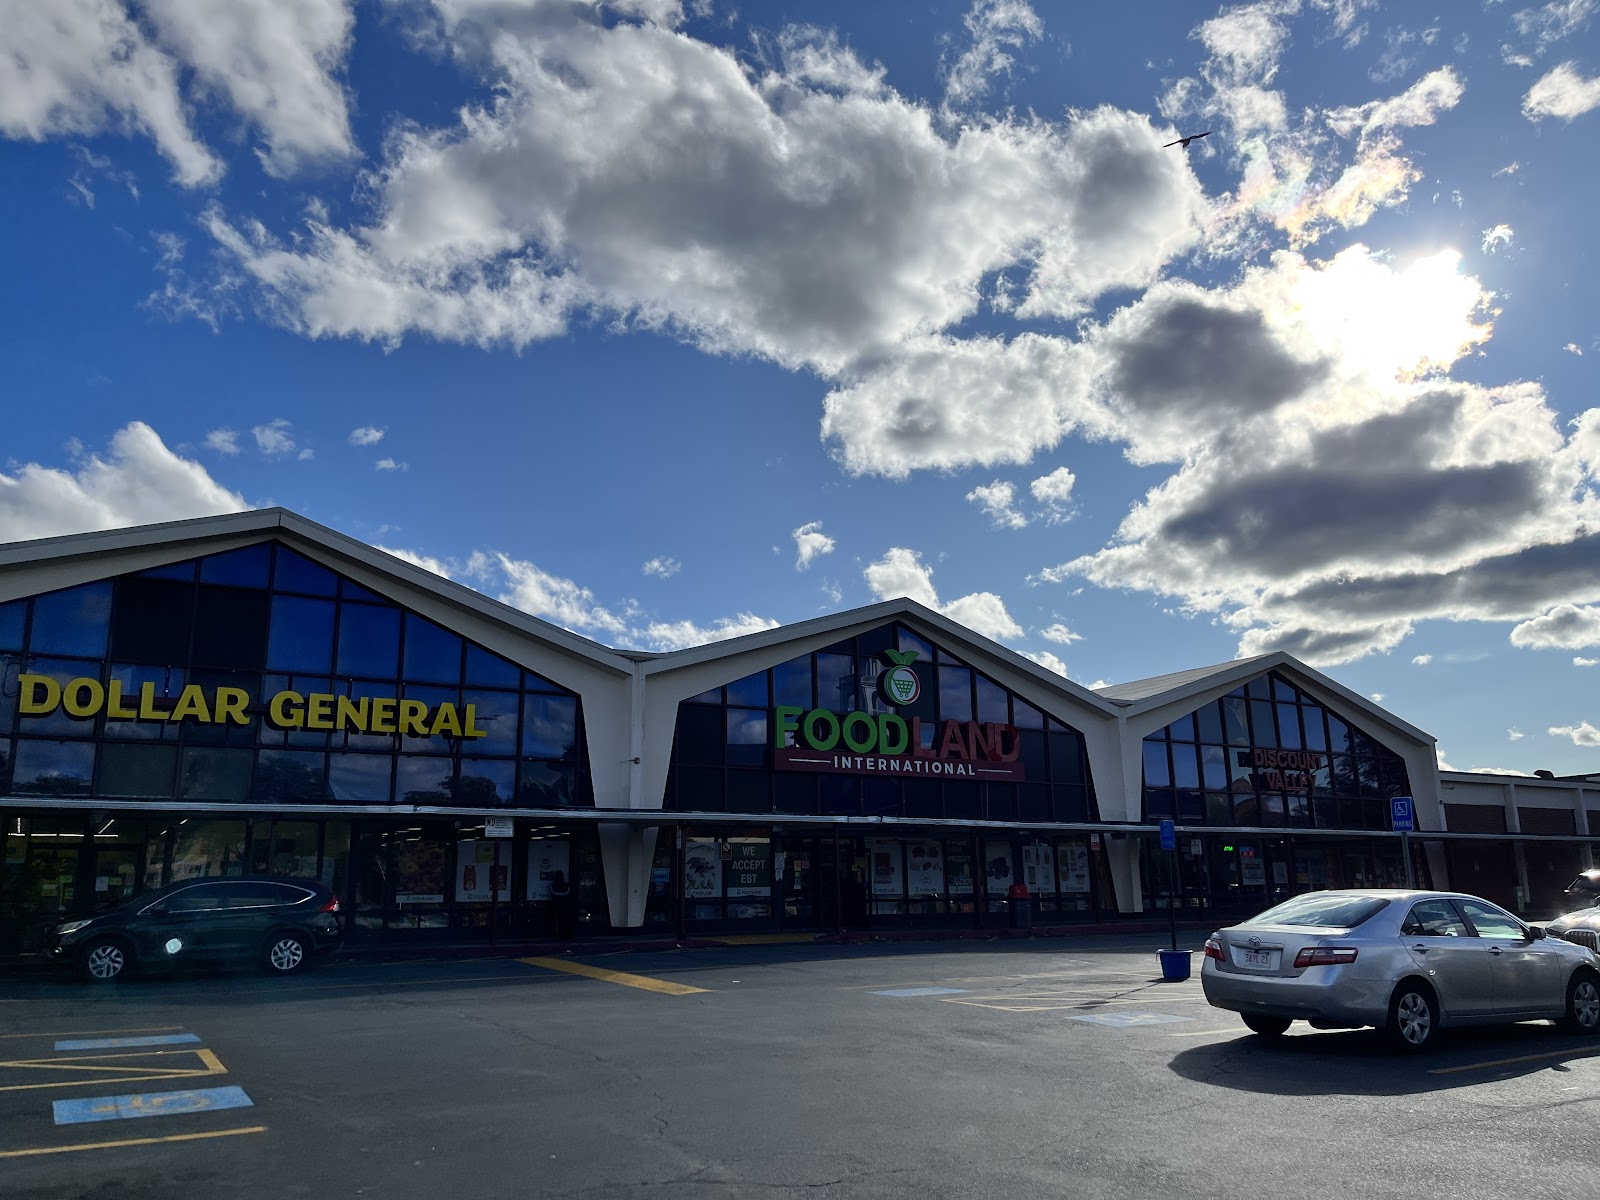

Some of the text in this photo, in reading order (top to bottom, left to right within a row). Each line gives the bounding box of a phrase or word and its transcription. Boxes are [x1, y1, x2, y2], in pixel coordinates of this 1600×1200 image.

[18, 674, 487, 738] DOLLAR GENERAL
[834, 756, 975, 776] INTERNATIONAL
[1254, 750, 1323, 769] DISCOUNT
[1266, 772, 1316, 791] VALLEY
[742, 846, 755, 856] WE
[732, 860, 766, 870] ACCEPT
[741, 873, 757, 884] EBT
